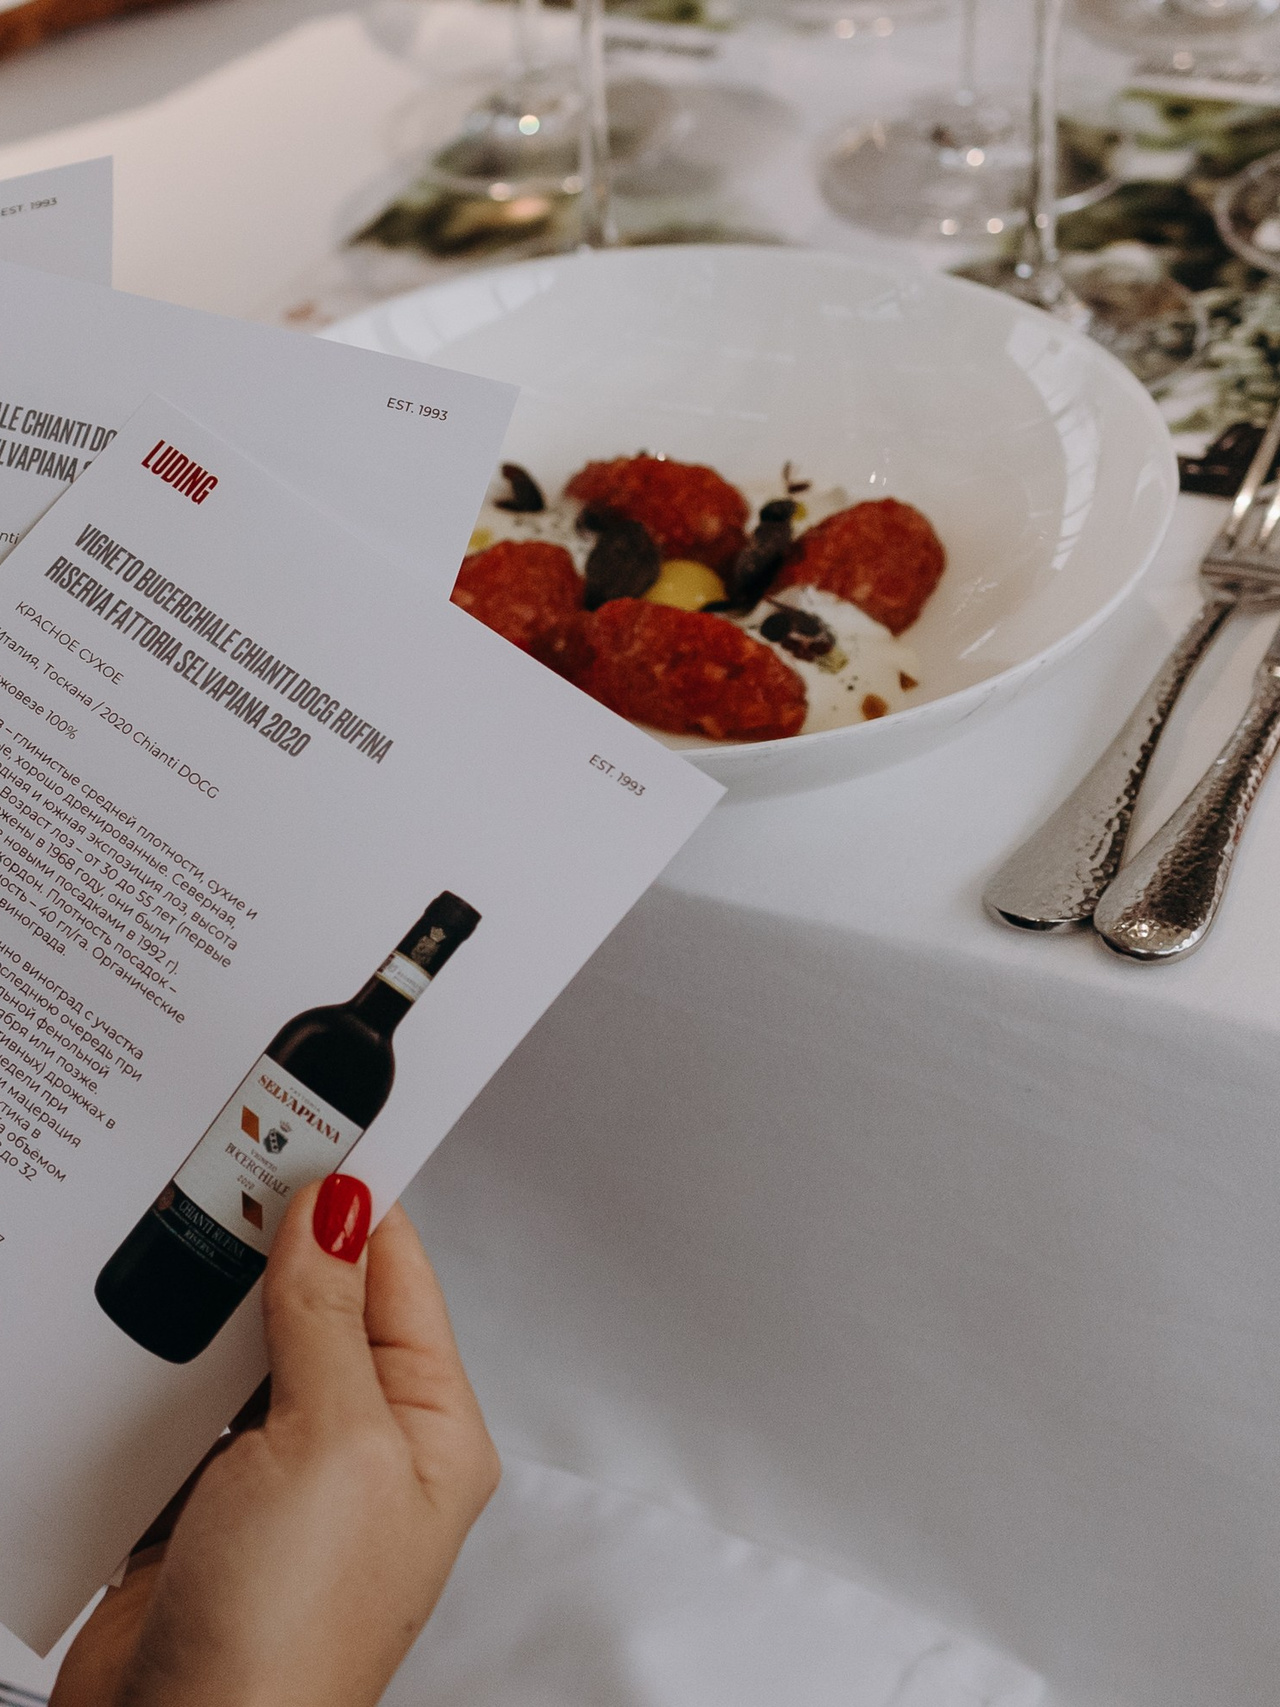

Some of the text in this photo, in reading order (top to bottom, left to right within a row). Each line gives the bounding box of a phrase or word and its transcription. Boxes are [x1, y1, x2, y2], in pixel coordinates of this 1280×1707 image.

[20, 409, 92, 448] CHIANTI
[386, 397, 447, 420] EST. 1993
[140, 439, 218, 504] LUDING
[15, 601, 123, 684] КРАСНОЕ СУХОЕ
[44, 555, 311, 756] RISERVA FATTORIA SELVAPIANA 2020
[74, 523, 393, 763] VIGNETO BUCERCHIALE CHIANTI DOCG RUFINA
[43, 662, 92, 706] Тоскана
[99, 706, 132, 734] 2020
[133, 731, 179, 769] Chianti
[177, 764, 219, 798] DOCG
[45, 709, 77, 739] 100%
[588, 754, 645, 795] EST. 1993
[0, 785, 52, 829] Возраст
[49, 827, 74, 848] лоз
[84, 853, 100, 866] от
[99, 861, 118, 880] 30
[114, 878, 135, 894] до
[135, 890, 154, 907] 55
[151, 905, 177, 924] лет
[175, 921, 230, 967] (первые
[12, 732, 80, 785] глинистые
[80, 784, 136, 828] средней
[136, 825, 204, 883] плотности,
[207, 879, 245, 910] сухие
[245, 908, 257, 919] и
[13, 755, 63, 795] хорошо
[61, 793, 167, 877] дренированные.
[171, 873, 235, 929] Северная,
[31, 790, 42, 801] и
[42, 798, 86, 835] южная
[86, 832, 163, 893] экспозиция
[162, 891, 187, 916] лоз,
[190, 911, 237, 950] высота
[3, 835, 55, 877] новыми
[54, 875, 125, 932] посадками
[125, 929, 135, 940] в
[137, 934, 166, 963] 1992
[164, 959, 178, 974] г).
[35, 837, 45, 848] в
[45, 842, 75, 870] 1968
[74, 867, 105, 897] году,
[107, 893, 134, 916] они
[134, 911, 170, 943] были
[45, 888, 111, 945] Плотность
[113, 942, 168, 988] посадок
[38, 906, 56, 922] 40
[55, 920, 87, 950] гл/га.
[92, 946, 184, 1023] Органические
[257, 1074, 341, 1144] SELVAPIANA
[225, 1142, 290, 1197] BUCERCHIALE
